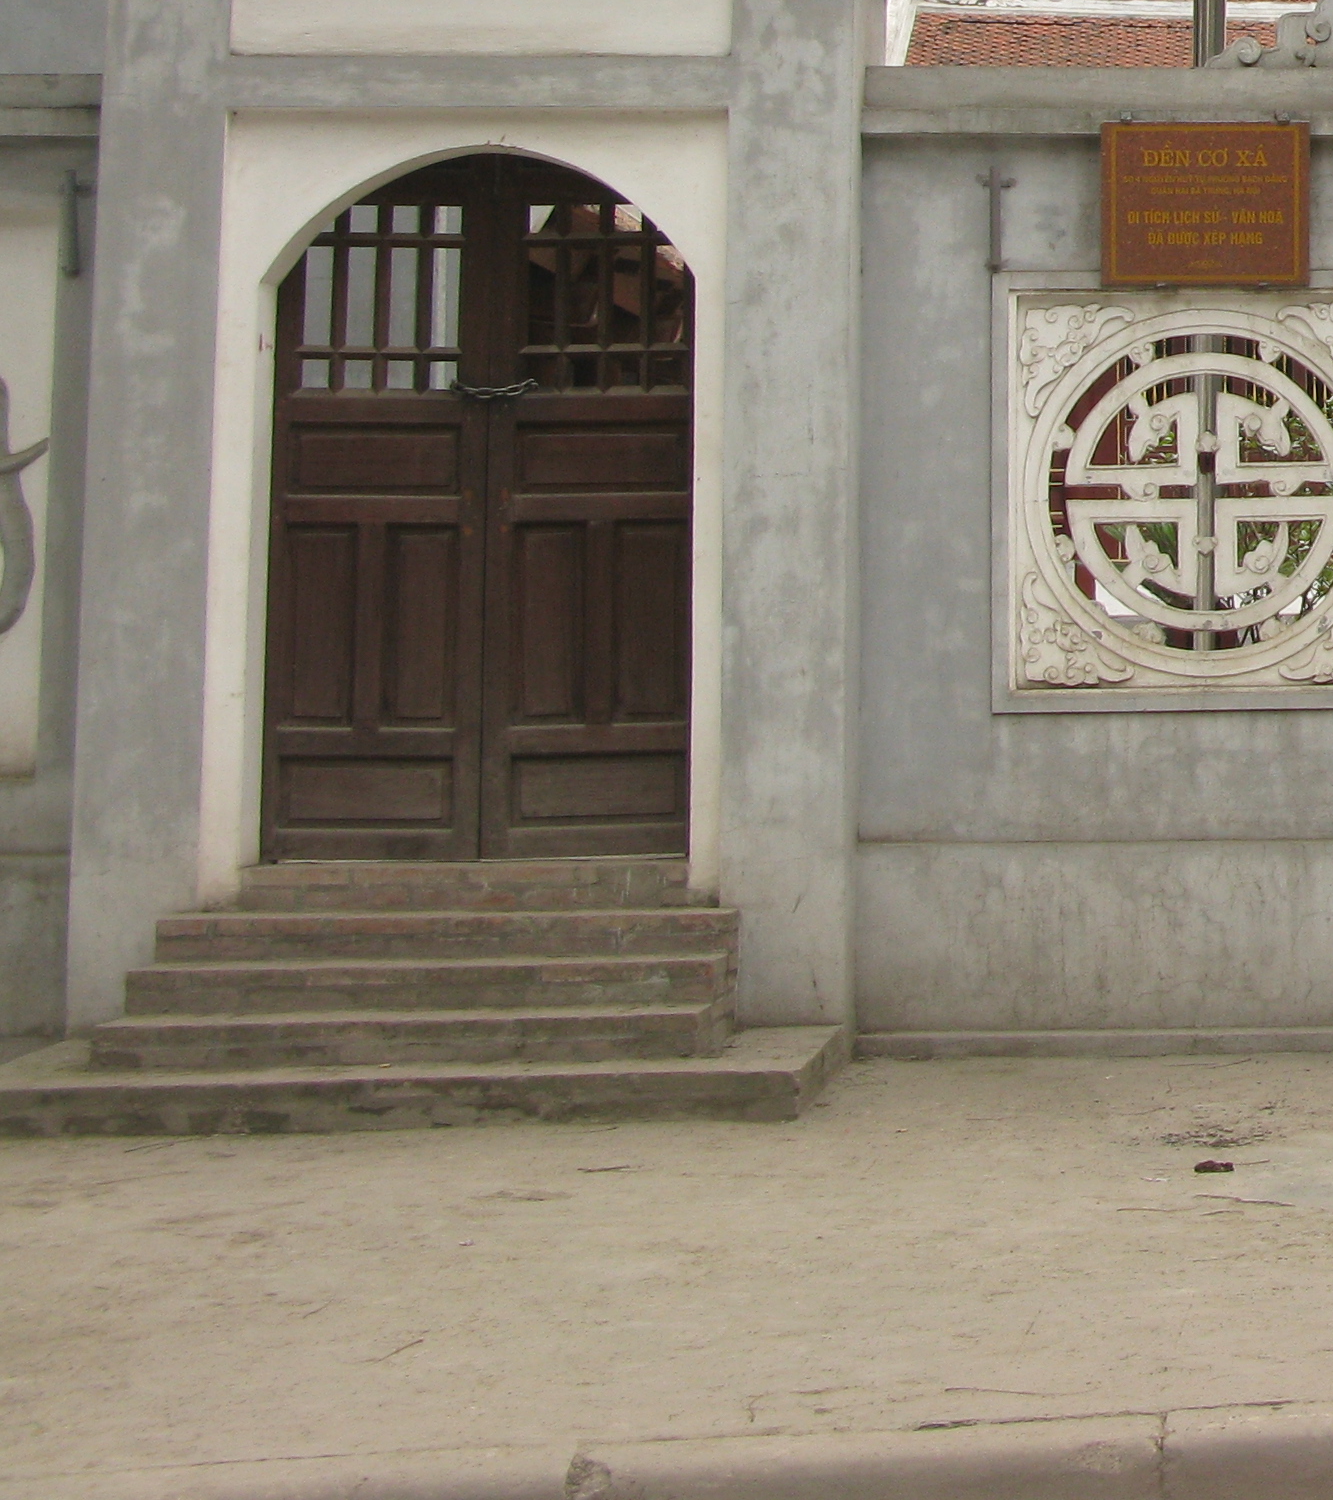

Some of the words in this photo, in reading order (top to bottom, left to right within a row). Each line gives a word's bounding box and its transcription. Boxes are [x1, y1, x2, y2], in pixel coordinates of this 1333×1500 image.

[1143, 141, 1191, 167] ĐỀN
[1198, 148, 1229, 167] CƠ
[1236, 144, 1268, 167] XÁ
[1145, 208, 1170, 224] TÍCH
[1232, 207, 1256, 224] VĂN
